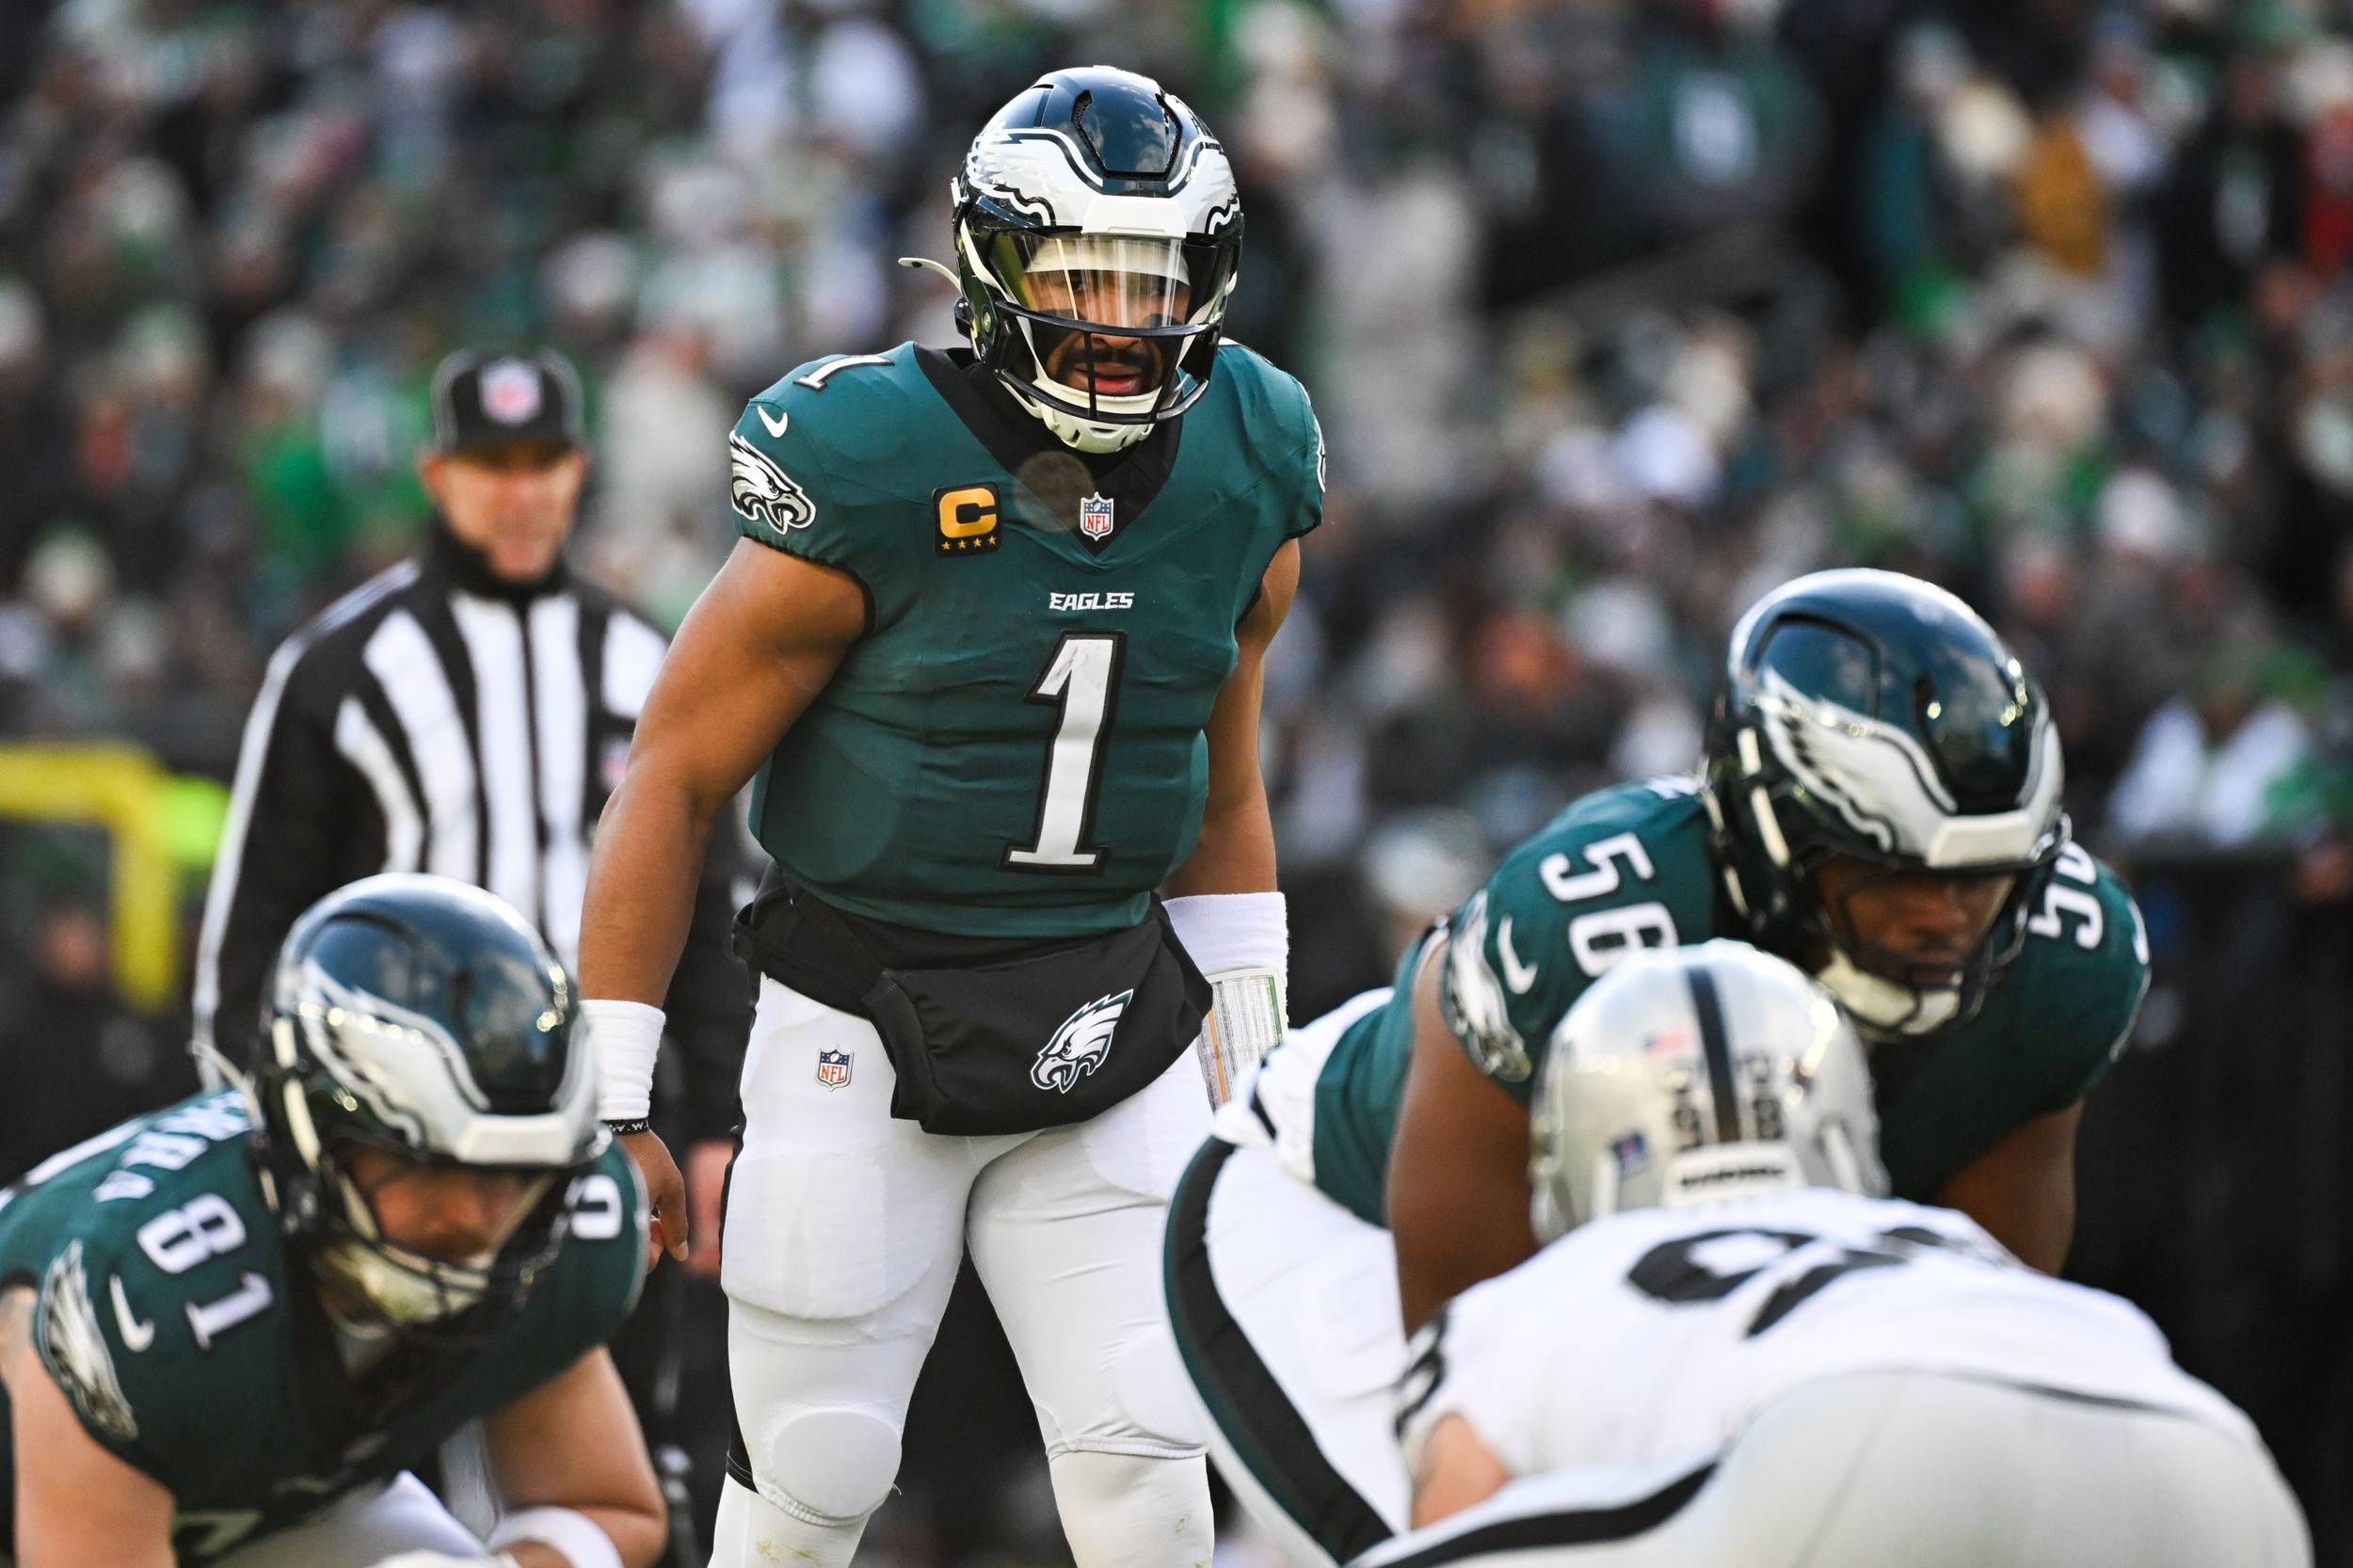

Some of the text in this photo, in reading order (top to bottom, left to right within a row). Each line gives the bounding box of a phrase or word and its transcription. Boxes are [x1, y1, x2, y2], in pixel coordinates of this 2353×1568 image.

[793, 355, 895, 394] 1
[939, 488, 997, 538] C
[1086, 515, 1109, 531] NFL
[1049, 592, 1134, 611] EAGLES
[1000, 631, 1128, 875] 1
[1540, 832, 1678, 977] 56
[820, 1064, 845, 1083] NFL
[136, 1192, 273, 1350] 81
